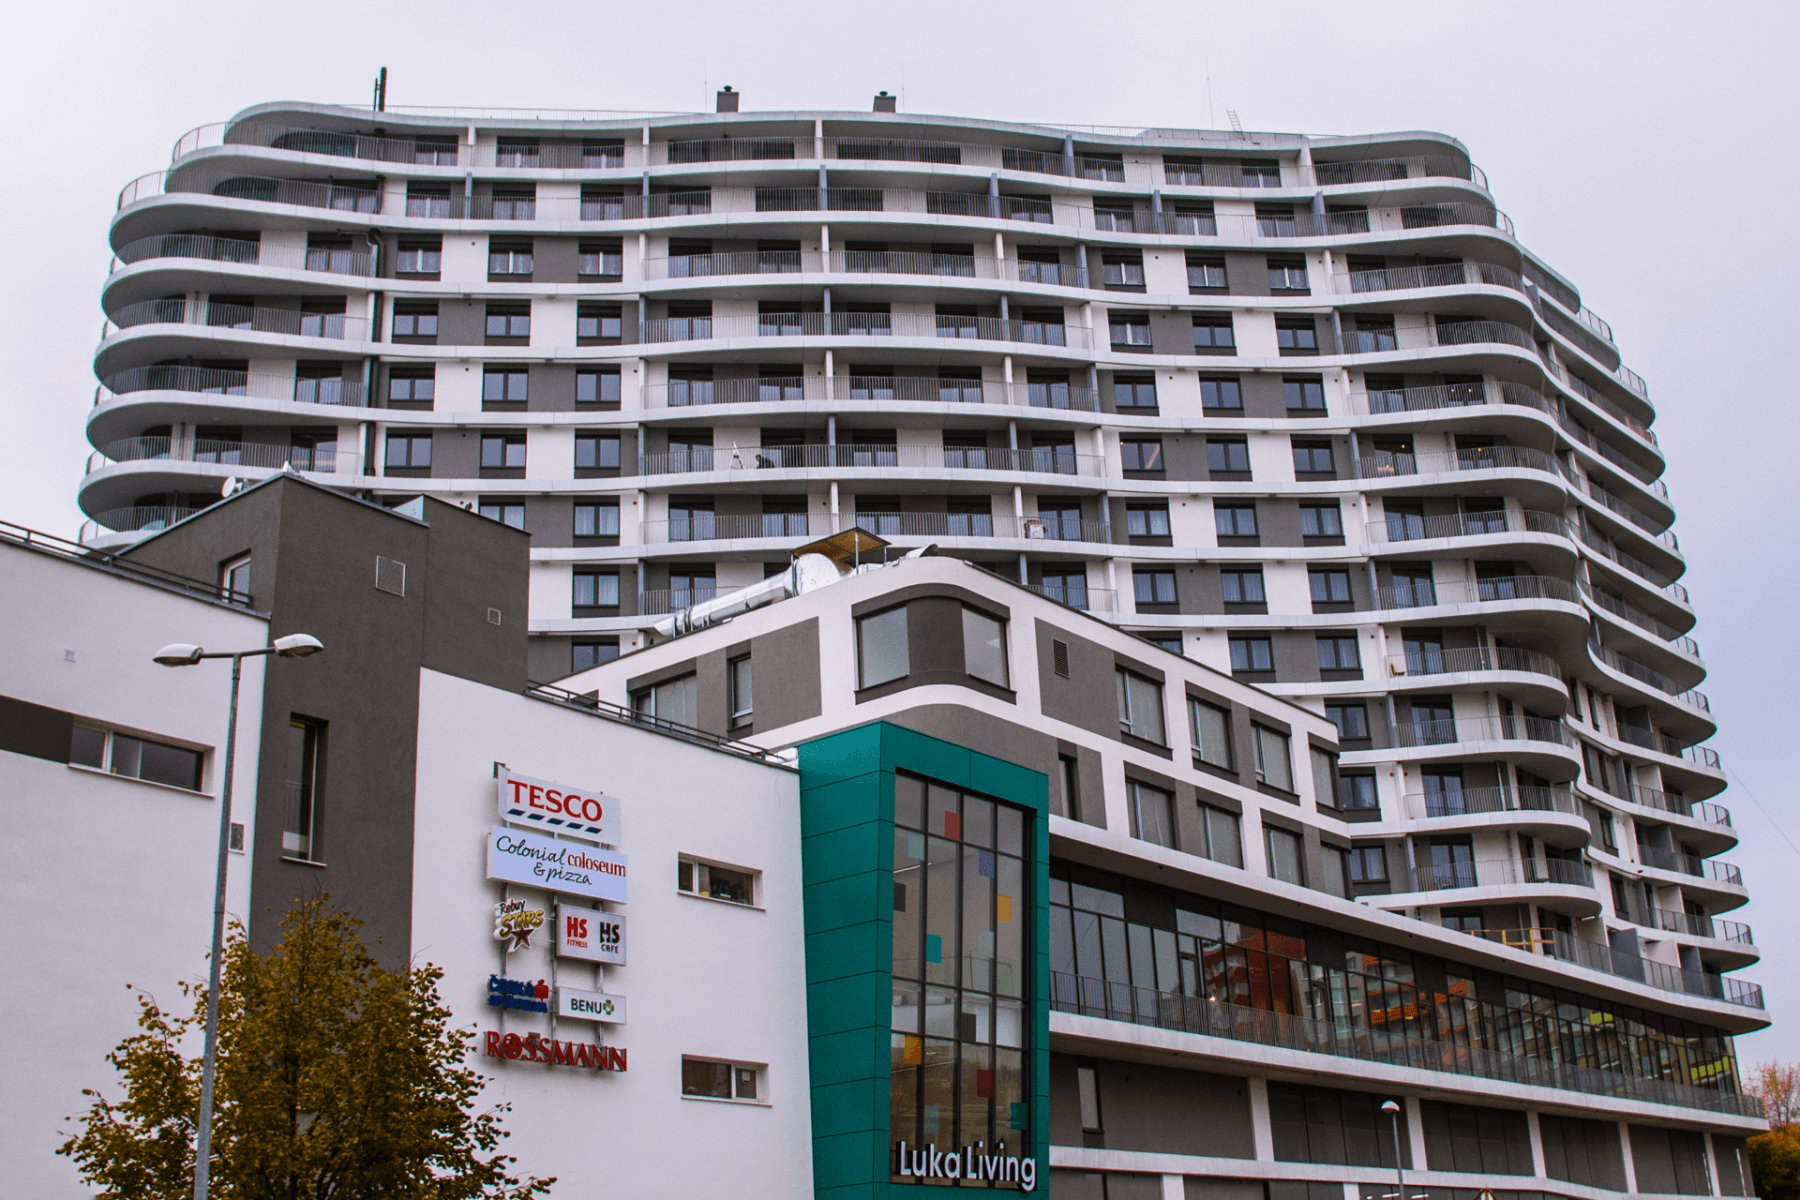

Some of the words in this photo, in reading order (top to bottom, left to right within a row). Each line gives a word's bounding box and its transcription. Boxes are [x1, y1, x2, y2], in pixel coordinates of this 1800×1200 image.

[507, 779, 603, 822] TESCO
[496, 836, 567, 865] Colonial
[567, 852, 626, 878] coloseum
[533, 861, 546, 877] &
[545, 866, 592, 885] pizza
[499, 899, 526, 915] Rebuy
[500, 910, 544, 938] STARS
[567, 916, 588, 939] HS
[600, 921, 620, 944] HS
[601, 943, 619, 954] CAFE
[571, 998, 602, 1014] BENU
[486, 1031, 627, 1072] ROSSMANN
